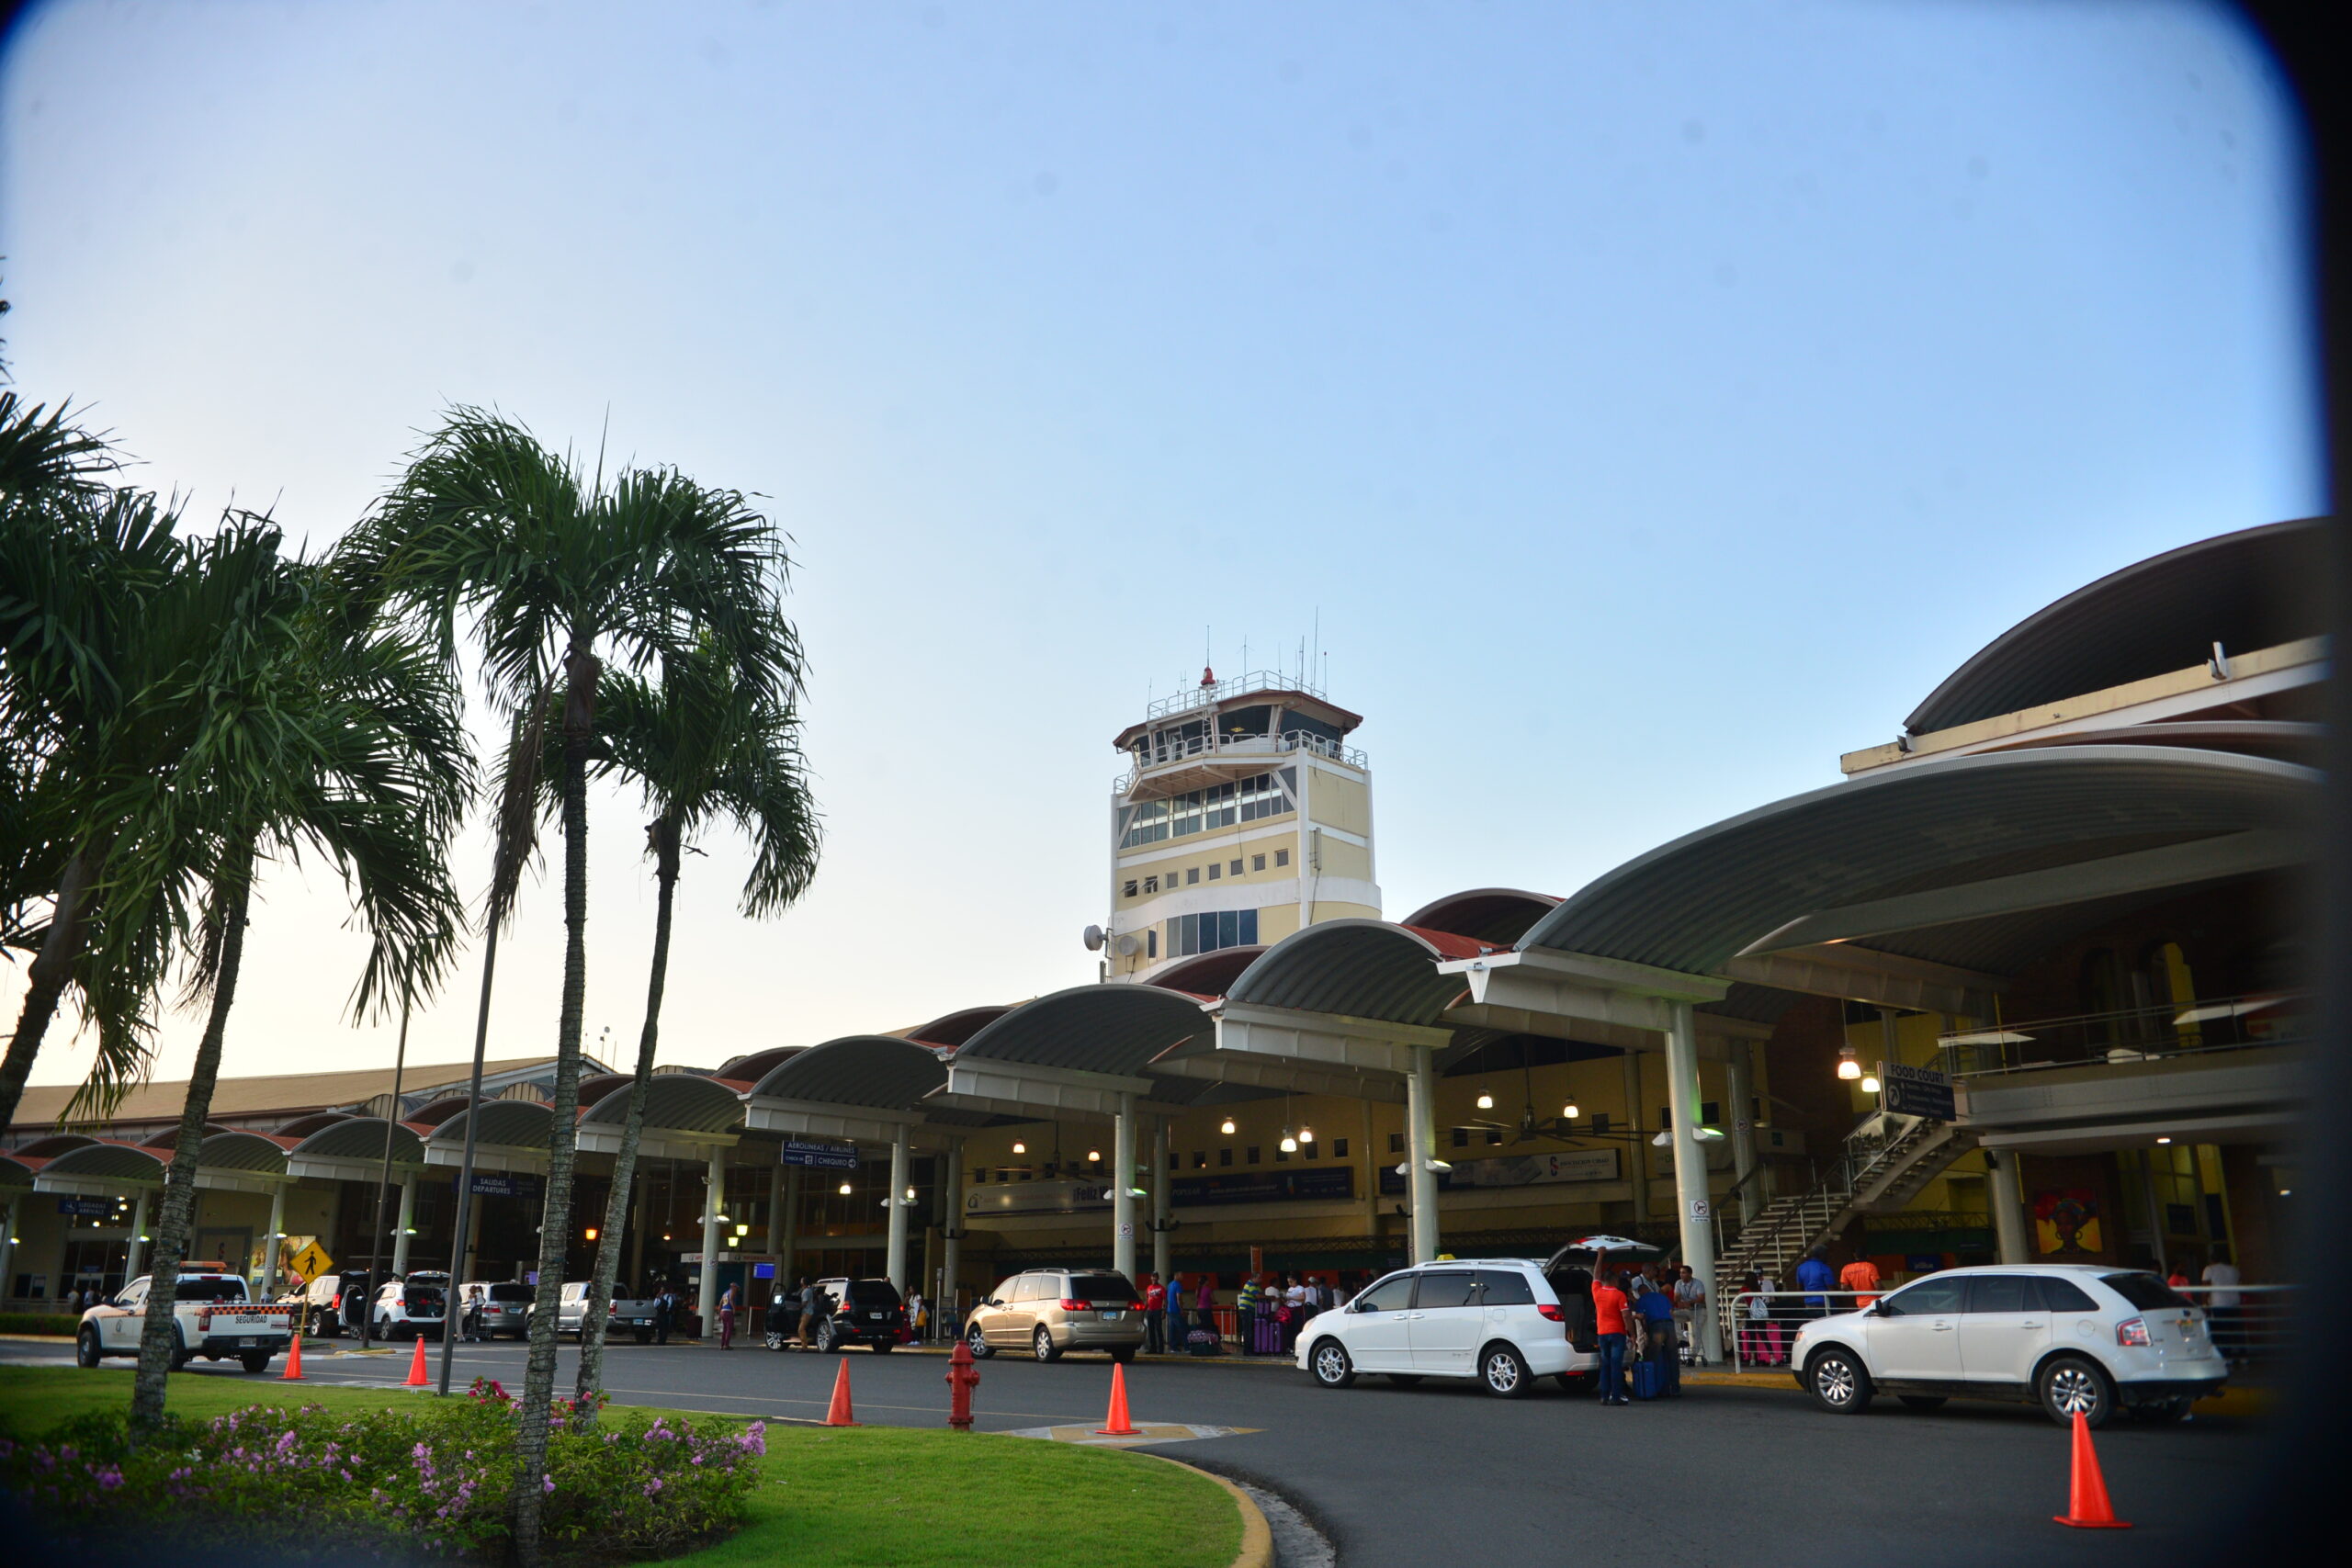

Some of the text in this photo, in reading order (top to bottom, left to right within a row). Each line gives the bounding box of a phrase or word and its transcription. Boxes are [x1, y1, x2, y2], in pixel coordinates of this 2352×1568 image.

[1891, 1064, 1944, 1084] FOOD COURT
[831, 1145, 854, 1154] AIRLINES
[818, 1157, 847, 1167] CHEQUEO
[480, 1178, 506, 1187] SALIDAS
[472, 1185, 511, 1195] DEPARTURES
[235, 1315, 267, 1324] SEGURIDAD
